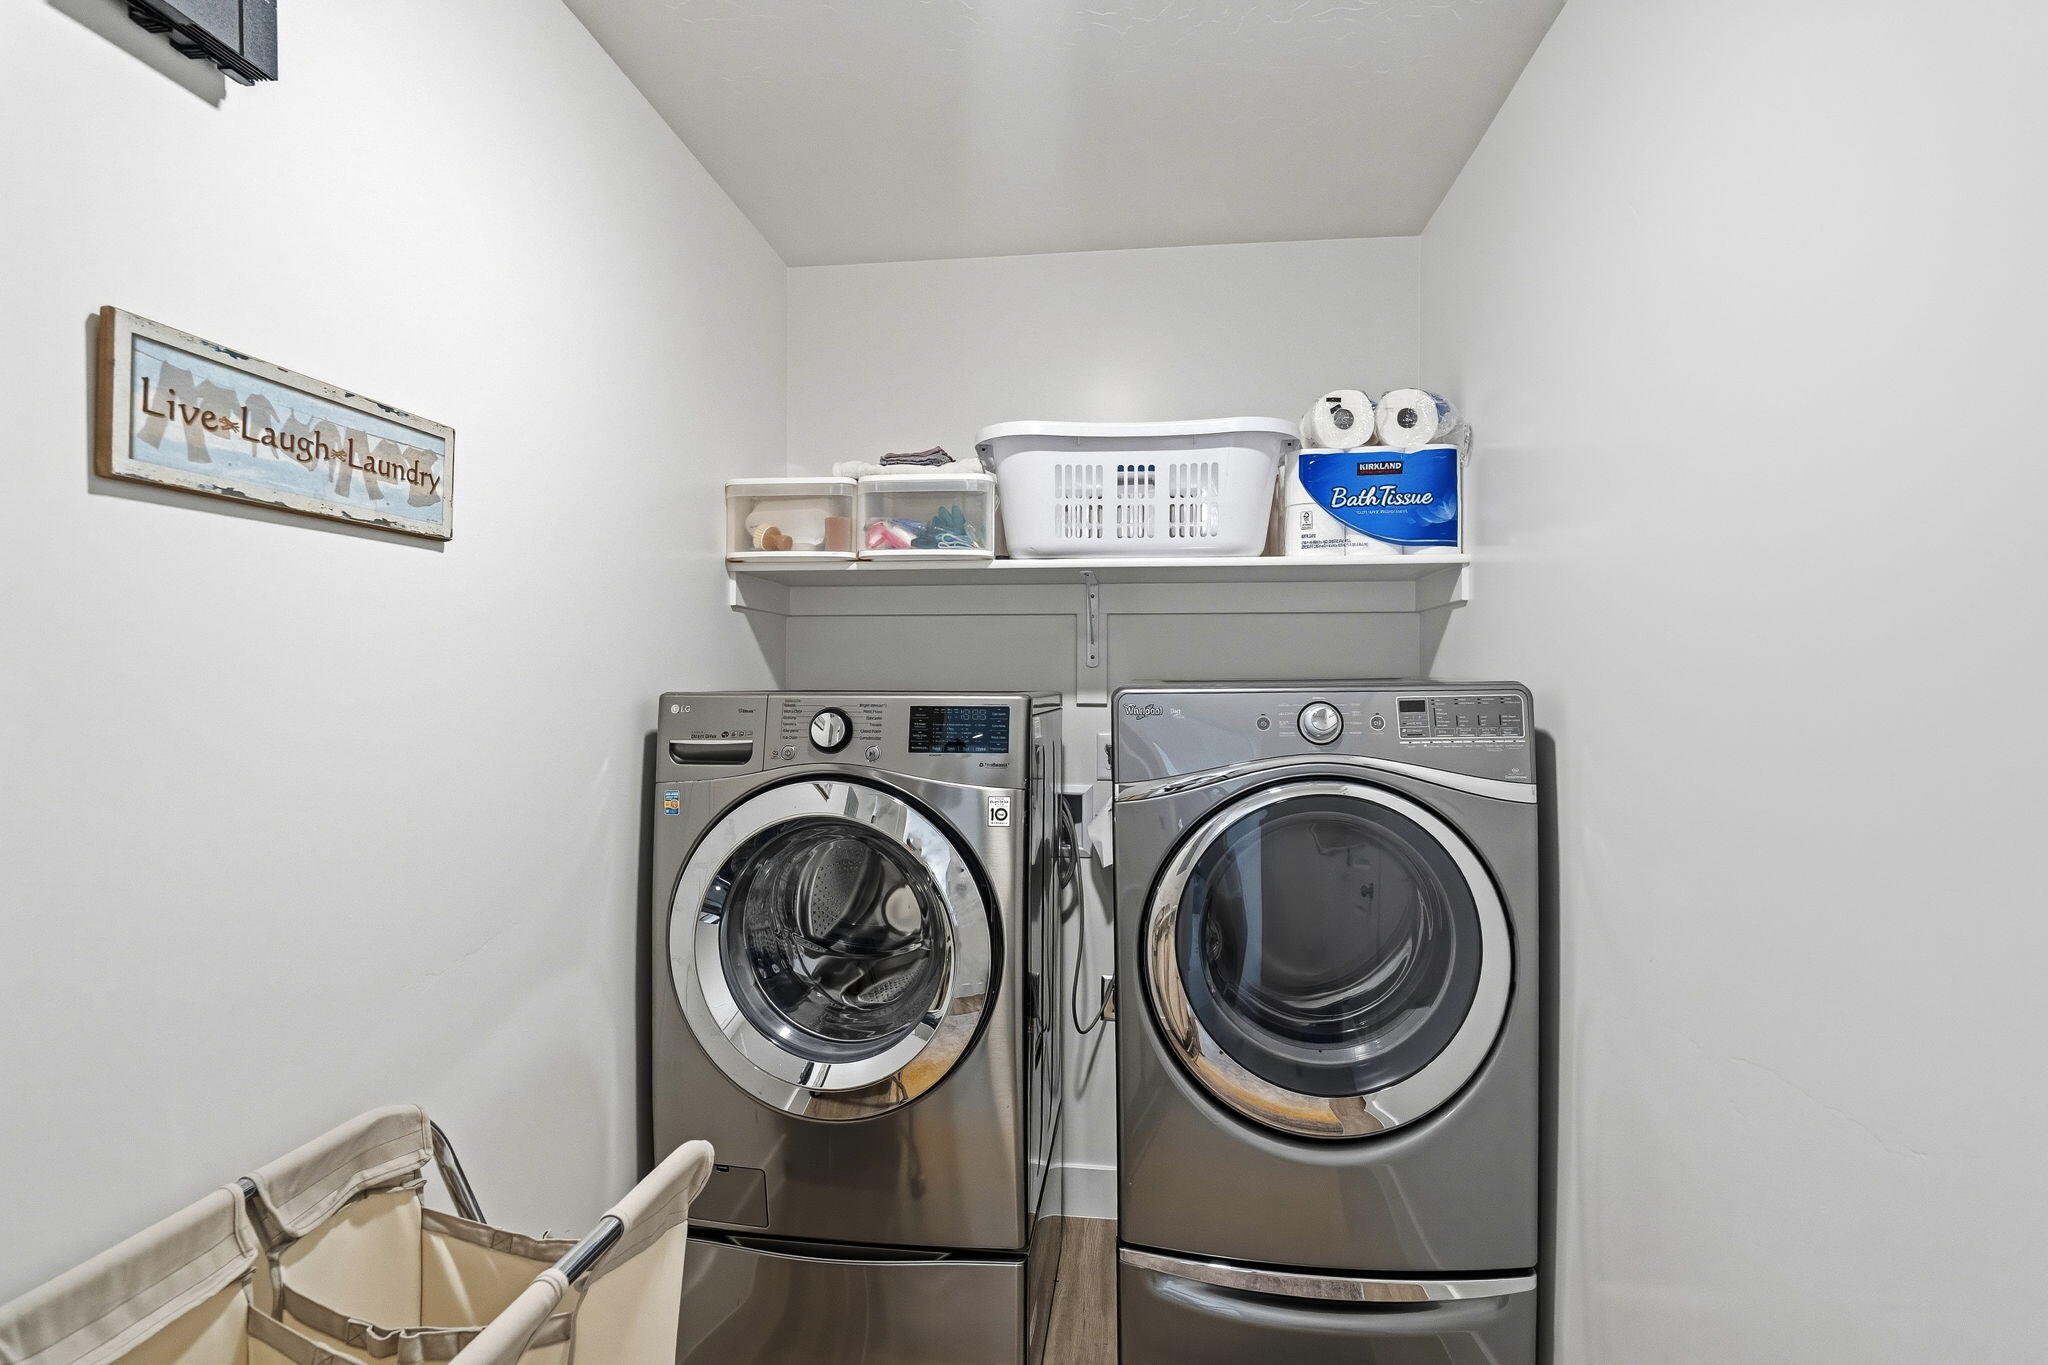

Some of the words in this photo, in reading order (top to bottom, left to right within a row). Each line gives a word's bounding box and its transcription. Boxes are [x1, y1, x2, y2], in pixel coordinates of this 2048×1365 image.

[141, 376, 219, 431] Live
[240, 406, 330, 463] Laugh
[347, 438, 441, 494] Laundry
[1359, 462, 1402, 471] KIRKLAND
[1331, 487, 1380, 508] Bath
[1379, 485, 1433, 506] Tissue
[990, 807, 1008, 821] 10
